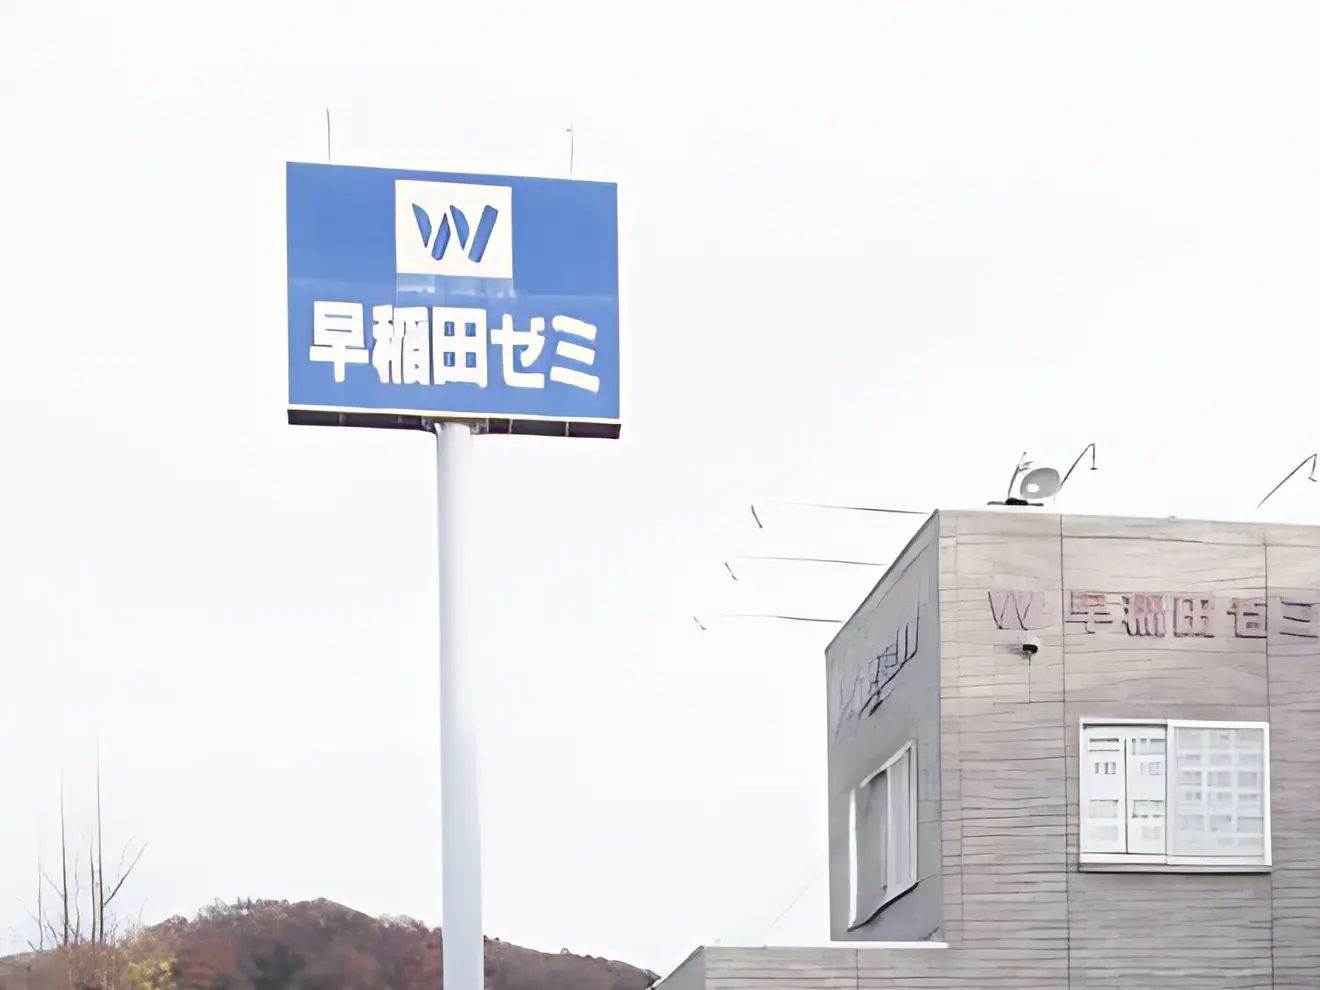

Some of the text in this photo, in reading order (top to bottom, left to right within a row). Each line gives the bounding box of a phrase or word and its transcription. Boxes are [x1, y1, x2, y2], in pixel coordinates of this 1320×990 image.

[412, 202, 498, 262] W
[309, 301, 600, 393] 早稲田ゼミ
